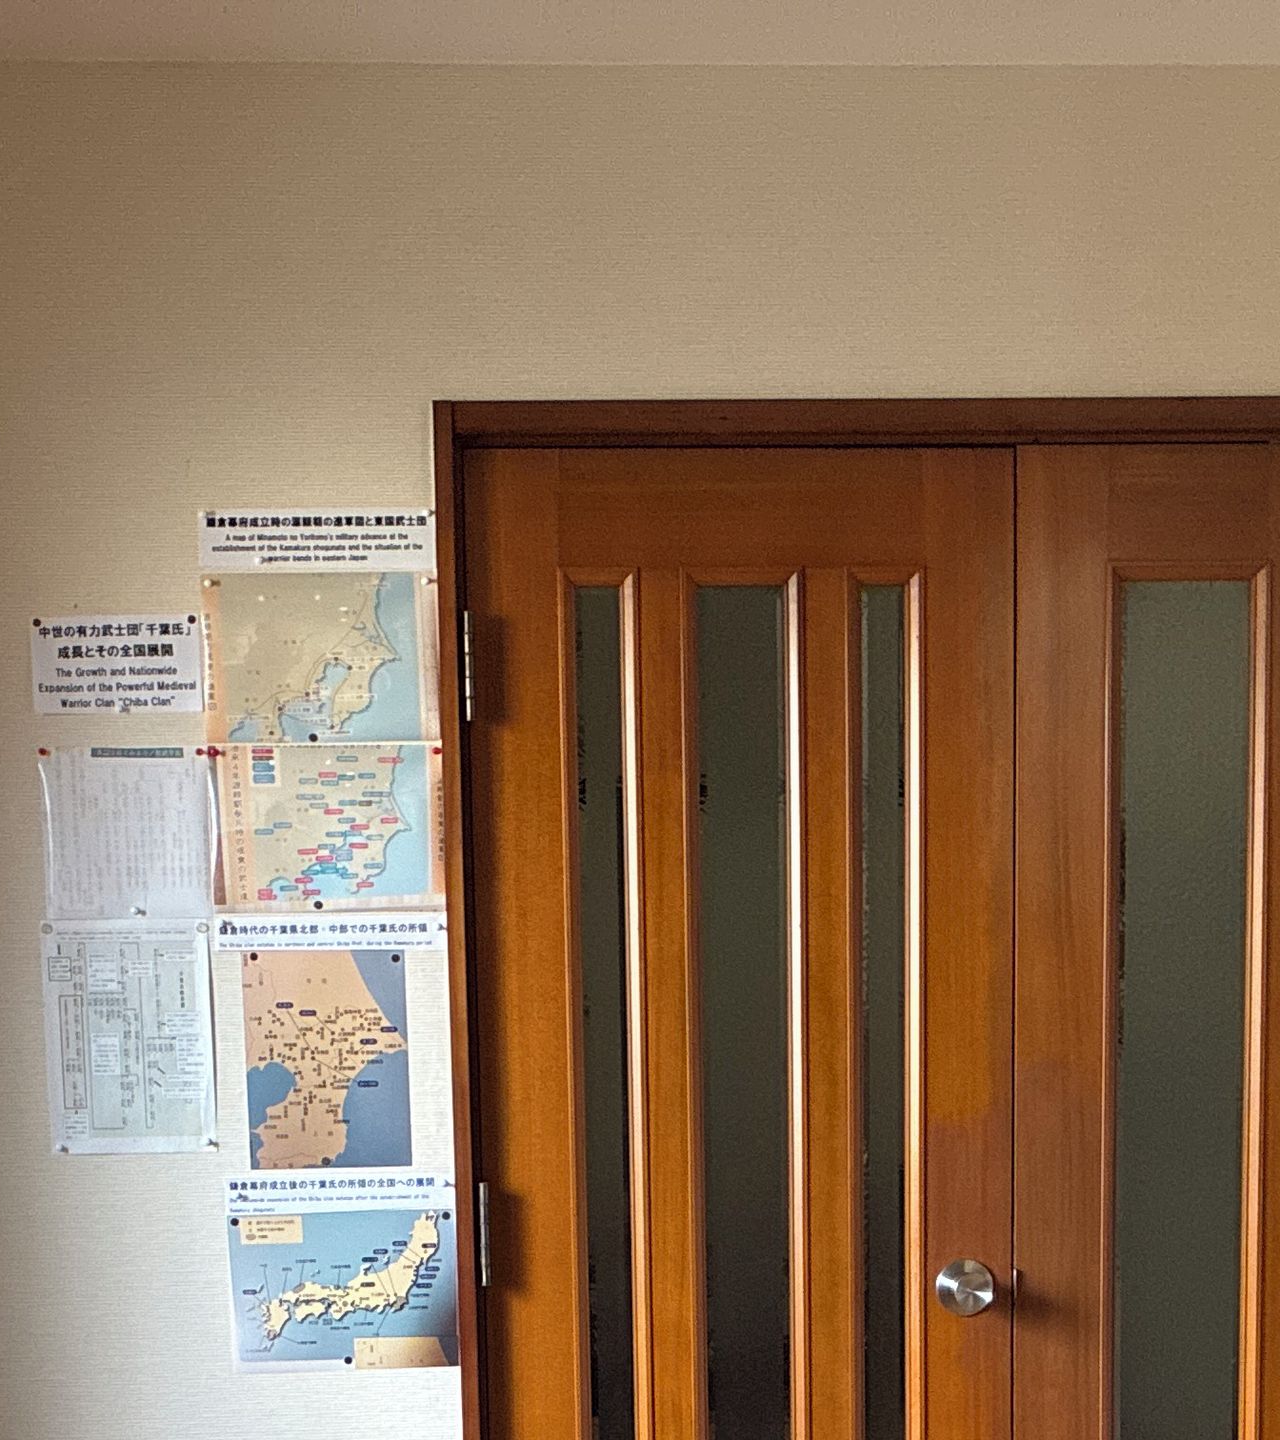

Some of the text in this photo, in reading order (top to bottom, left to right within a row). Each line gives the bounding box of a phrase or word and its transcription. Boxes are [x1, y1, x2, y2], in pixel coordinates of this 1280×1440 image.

[58, 643, 174, 659] 成長とその全国展開
[56, 665, 177, 677] The Growth and Nationwide
[38, 680, 196, 693] Expansion of the Powerful Medieval
[60, 698, 91, 708] Warrior
[95, 698, 115, 707] Clan
